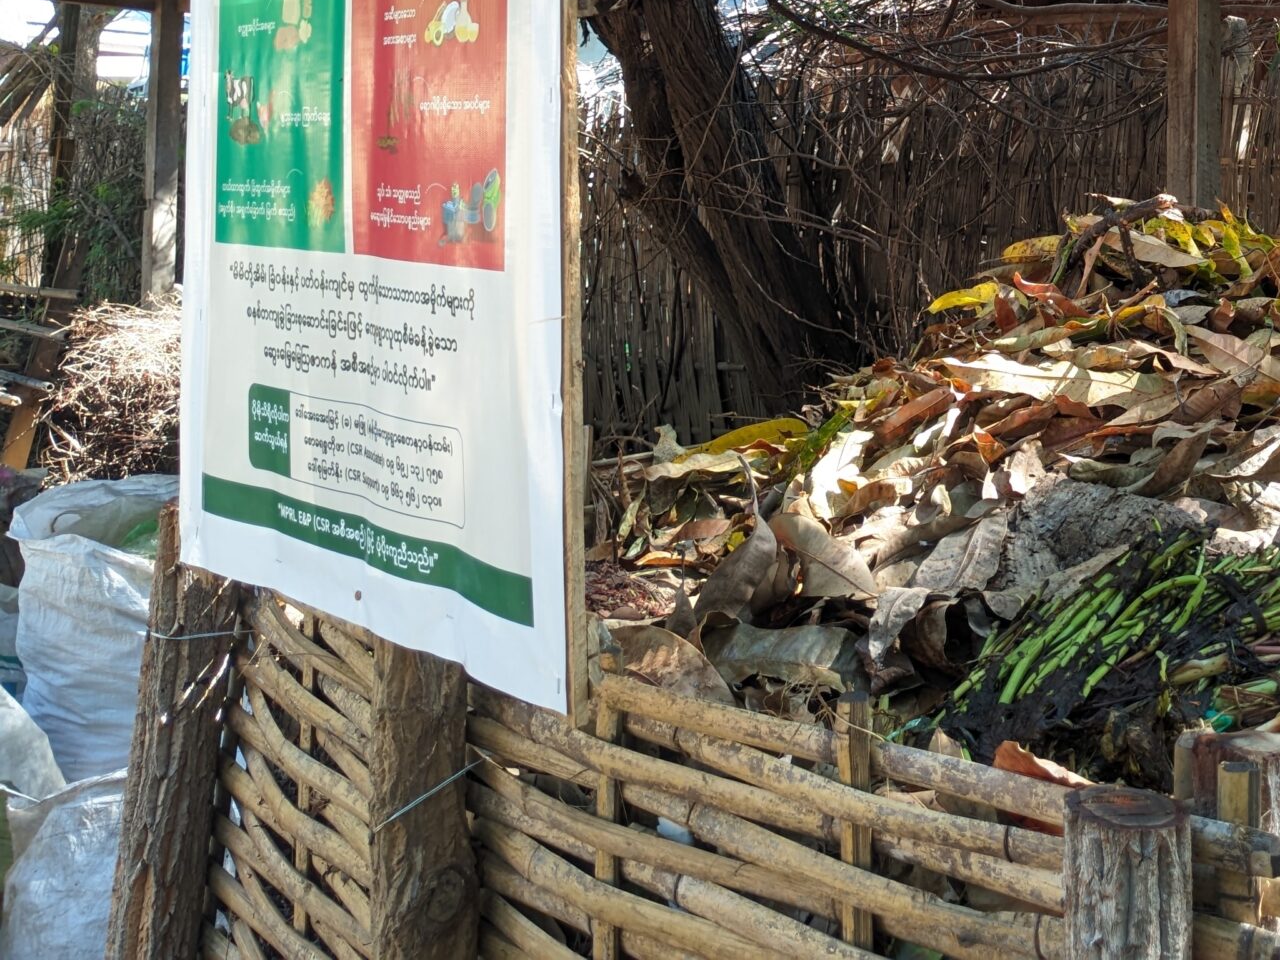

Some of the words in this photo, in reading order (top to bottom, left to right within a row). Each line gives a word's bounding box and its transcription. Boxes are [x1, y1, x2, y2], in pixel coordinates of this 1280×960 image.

[347, 441, 363, 456] (CSR
[344, 466, 361, 482] (CSR
[298, 510, 311, 526] E&P
[313, 514, 330, 533] (CSR
